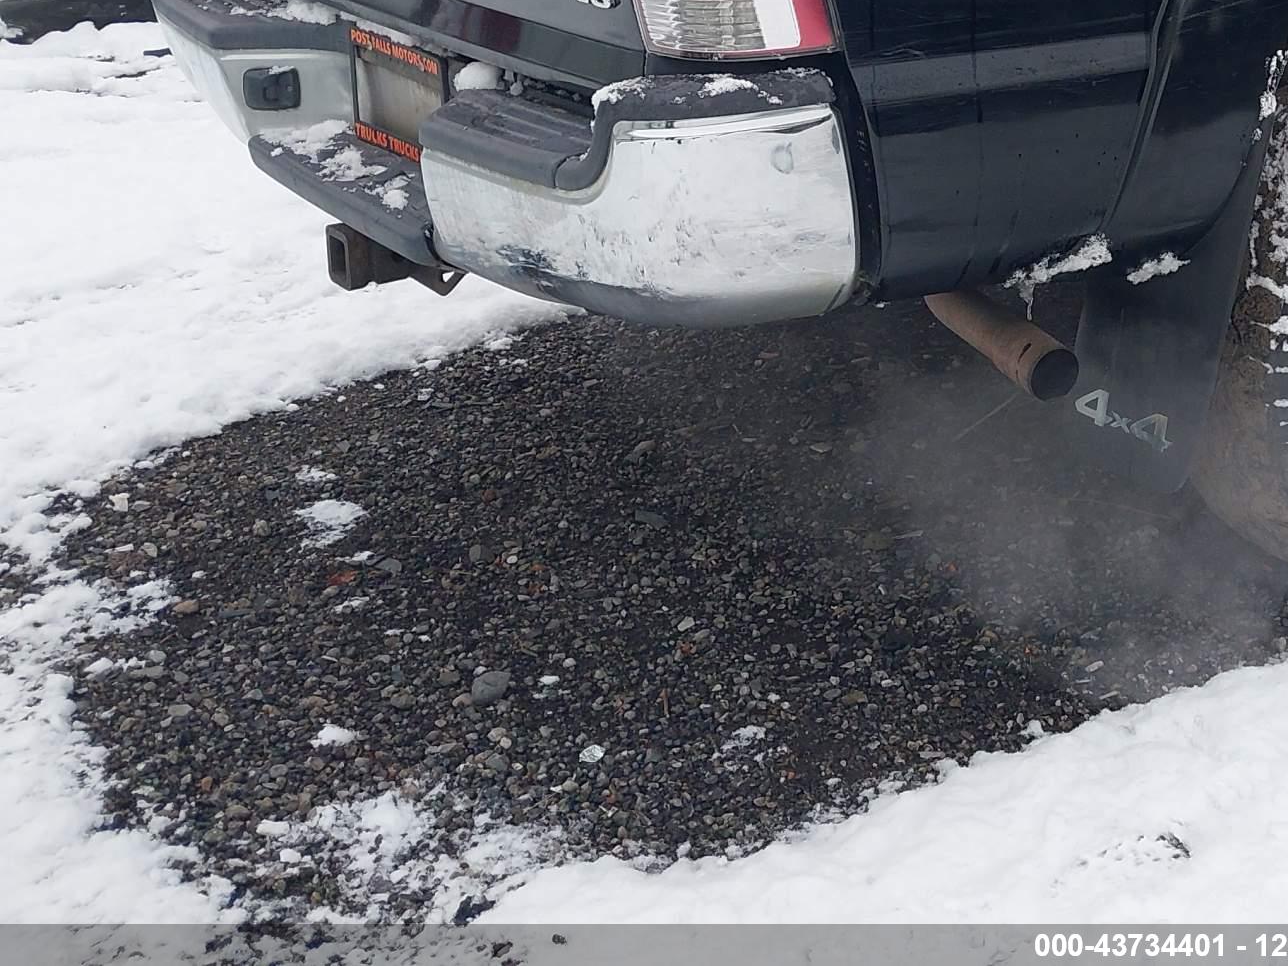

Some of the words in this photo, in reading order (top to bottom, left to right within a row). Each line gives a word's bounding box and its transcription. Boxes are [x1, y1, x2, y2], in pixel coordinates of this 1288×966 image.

[351, 28, 371, 44] POST
[391, 45, 438, 75] MOTORSCOM
[356, 122, 387, 147] TRUCKS
[388, 136, 419, 162] TRUCKS
[1074, 388, 1173, 453] 4x4
